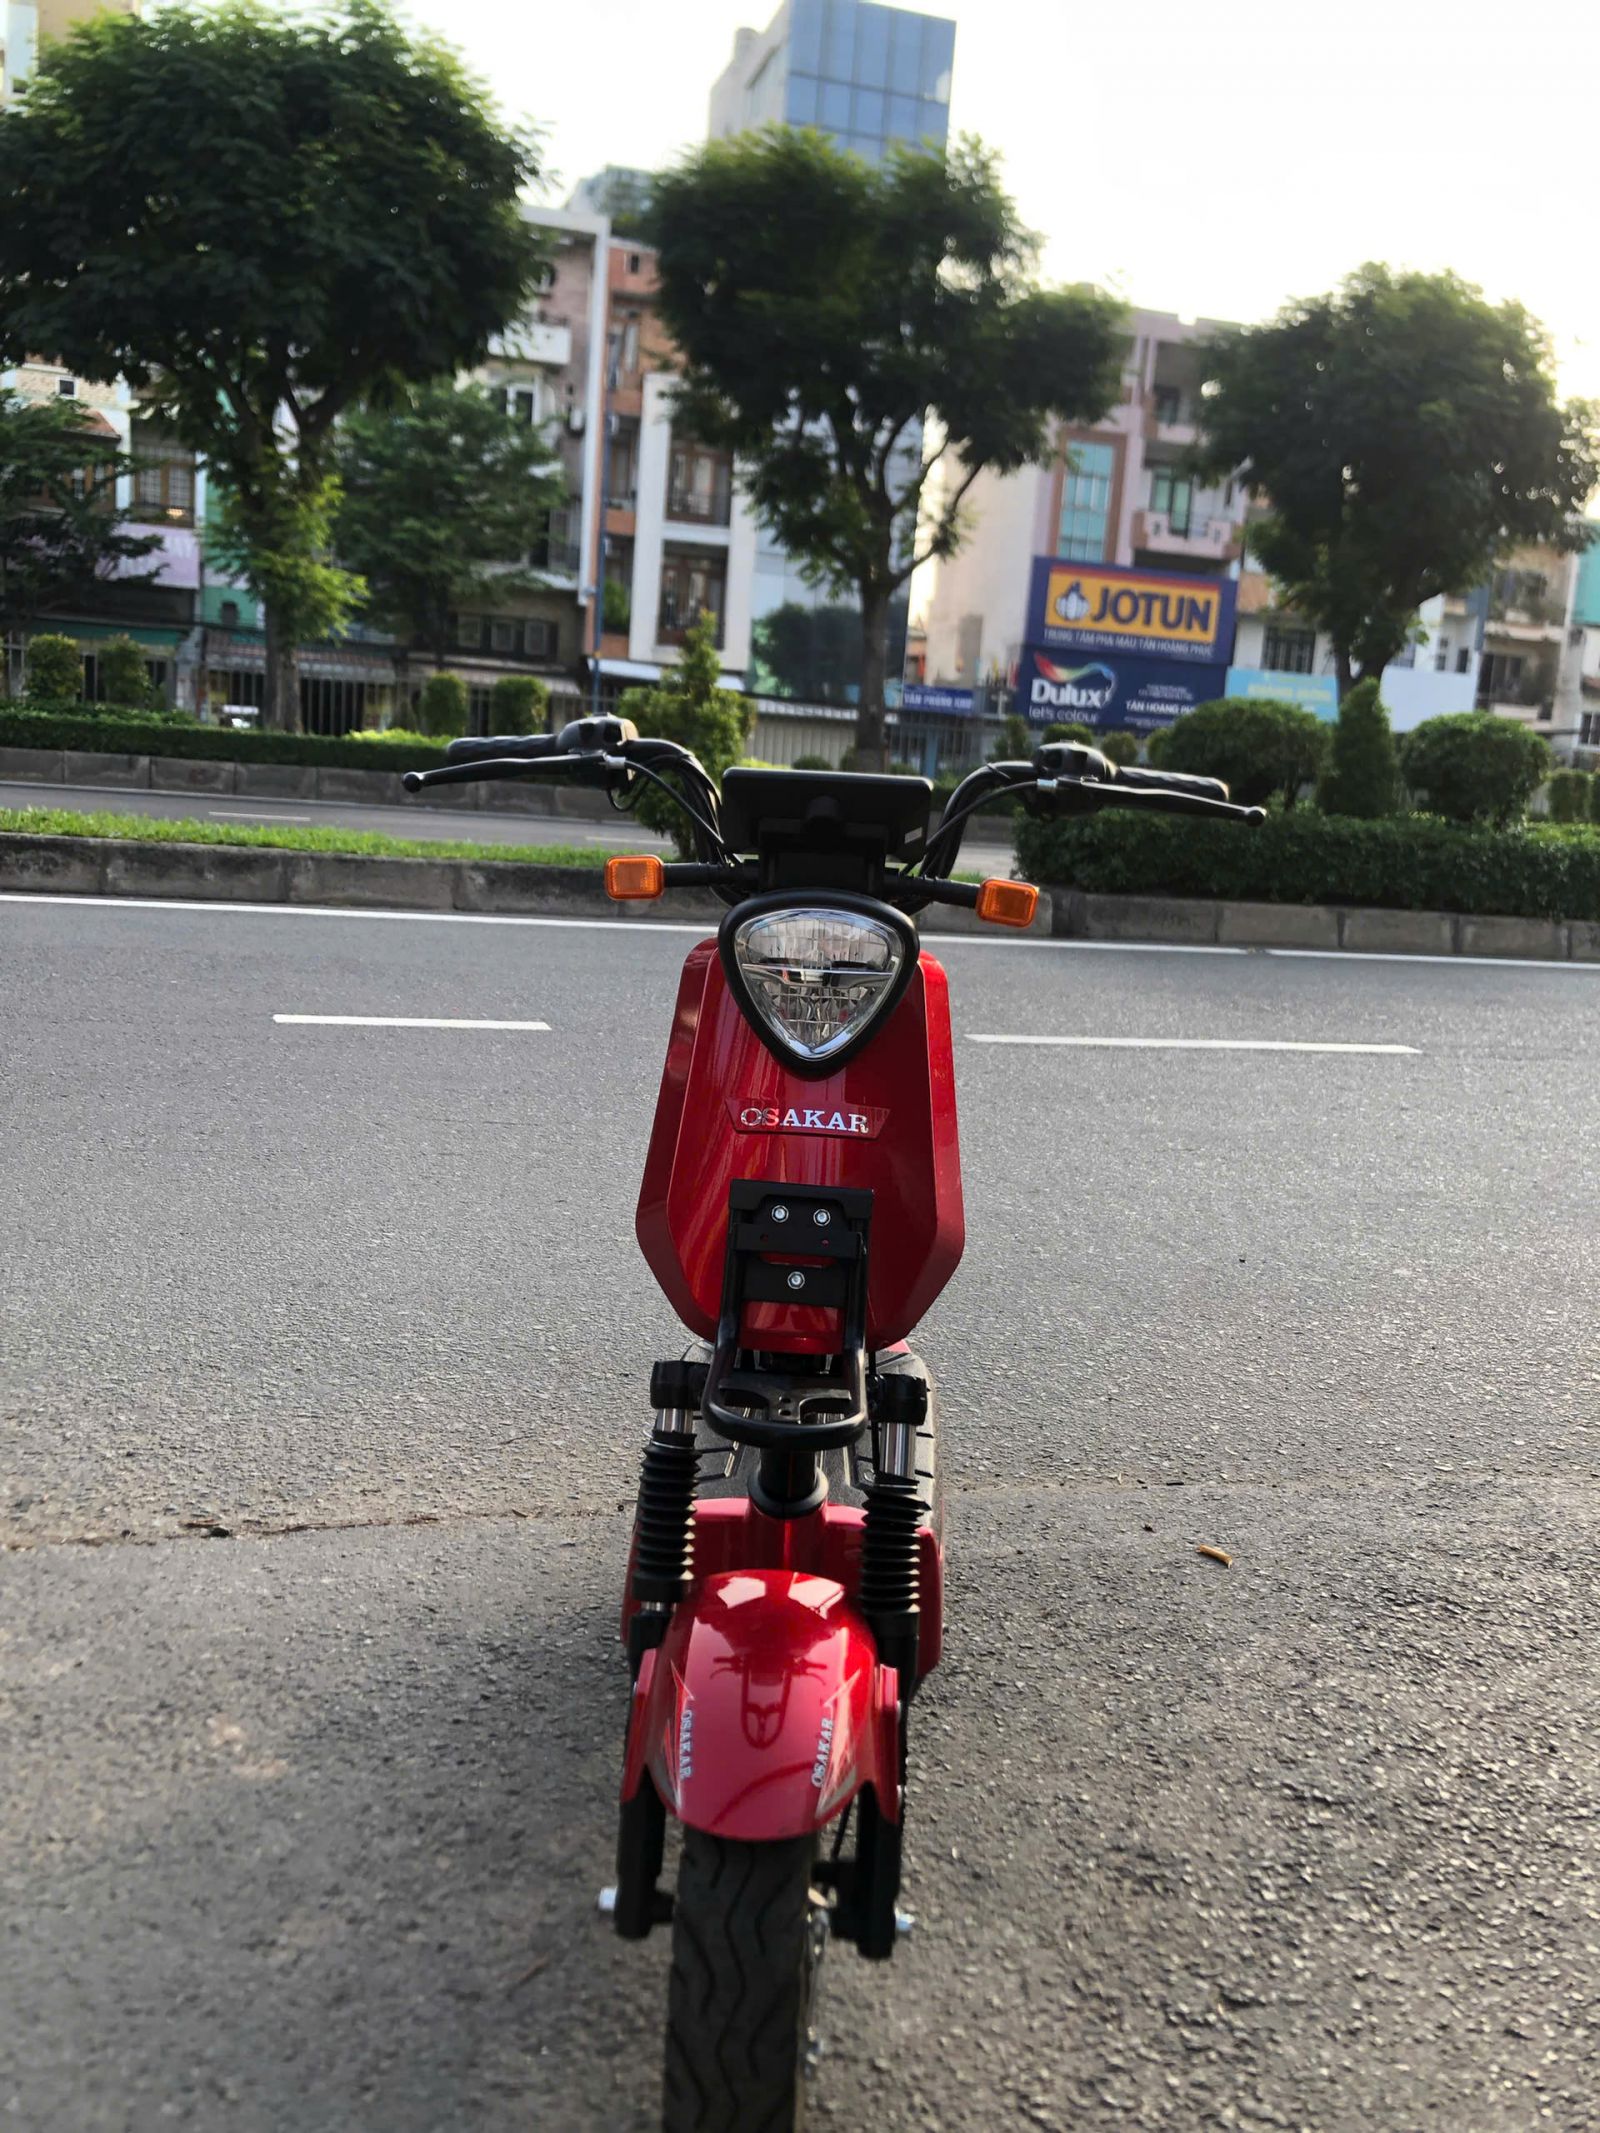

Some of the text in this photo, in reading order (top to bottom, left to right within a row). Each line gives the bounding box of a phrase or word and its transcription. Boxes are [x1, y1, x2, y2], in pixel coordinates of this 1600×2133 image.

[1092, 587, 1211, 632] JOTUN
[1031, 678, 1101, 707] Dulux
[1029, 706, 1098, 723] let's colour
[740, 1107, 869, 1133] OSAKAR
[680, 1709, 693, 1779] OSAKAR
[810, 1717, 834, 1788] OSAKAR
